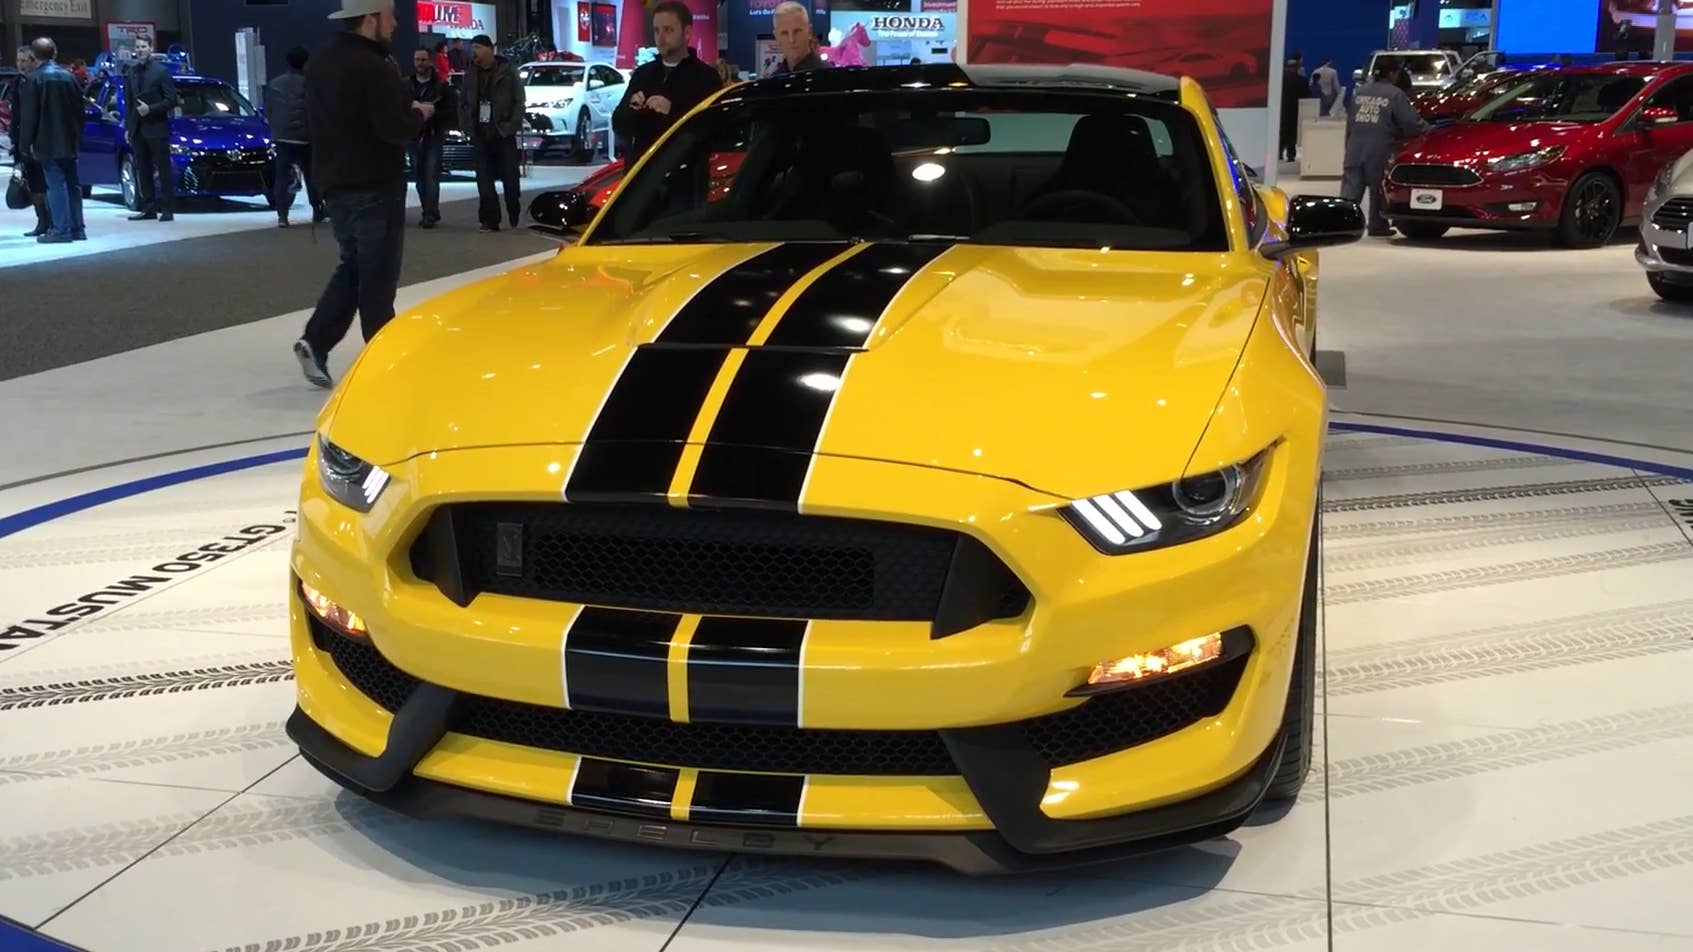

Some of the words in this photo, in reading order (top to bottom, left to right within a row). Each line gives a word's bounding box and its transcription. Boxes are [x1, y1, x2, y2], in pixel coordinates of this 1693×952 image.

[873, 16, 945, 29] HONDA
[1355, 112, 1380, 123] SHOW
[1359, 103, 1380, 114] AUTO
[152, 524, 286, 573] GT350
[0, 575, 172, 650] MUSTA
[534, 808, 836, 852] SHELBY
